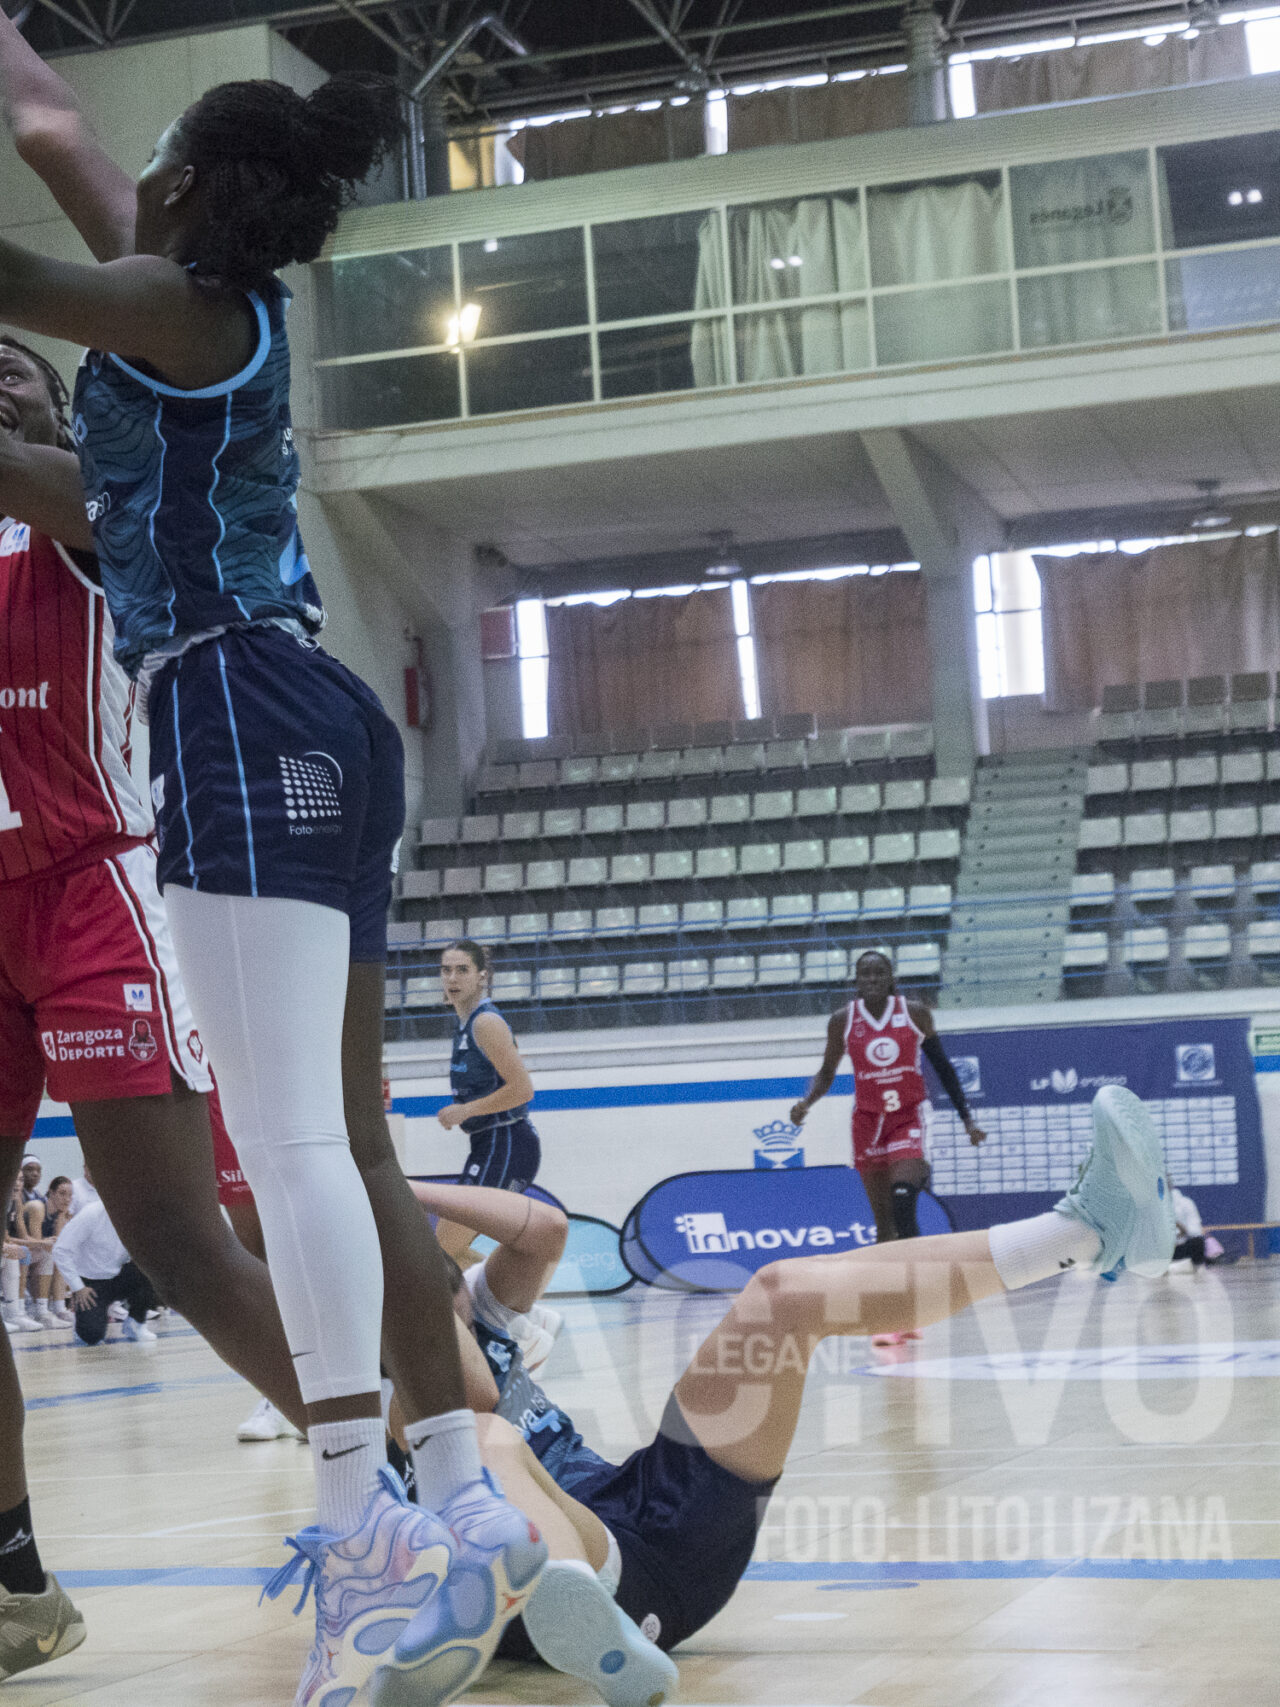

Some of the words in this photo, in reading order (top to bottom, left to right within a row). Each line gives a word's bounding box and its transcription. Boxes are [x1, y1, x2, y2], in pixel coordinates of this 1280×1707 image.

[56, 1027, 124, 1046] Zaragoza
[59, 1045, 125, 1062] DEPORTE
[882, 1090, 901, 1112] 3
